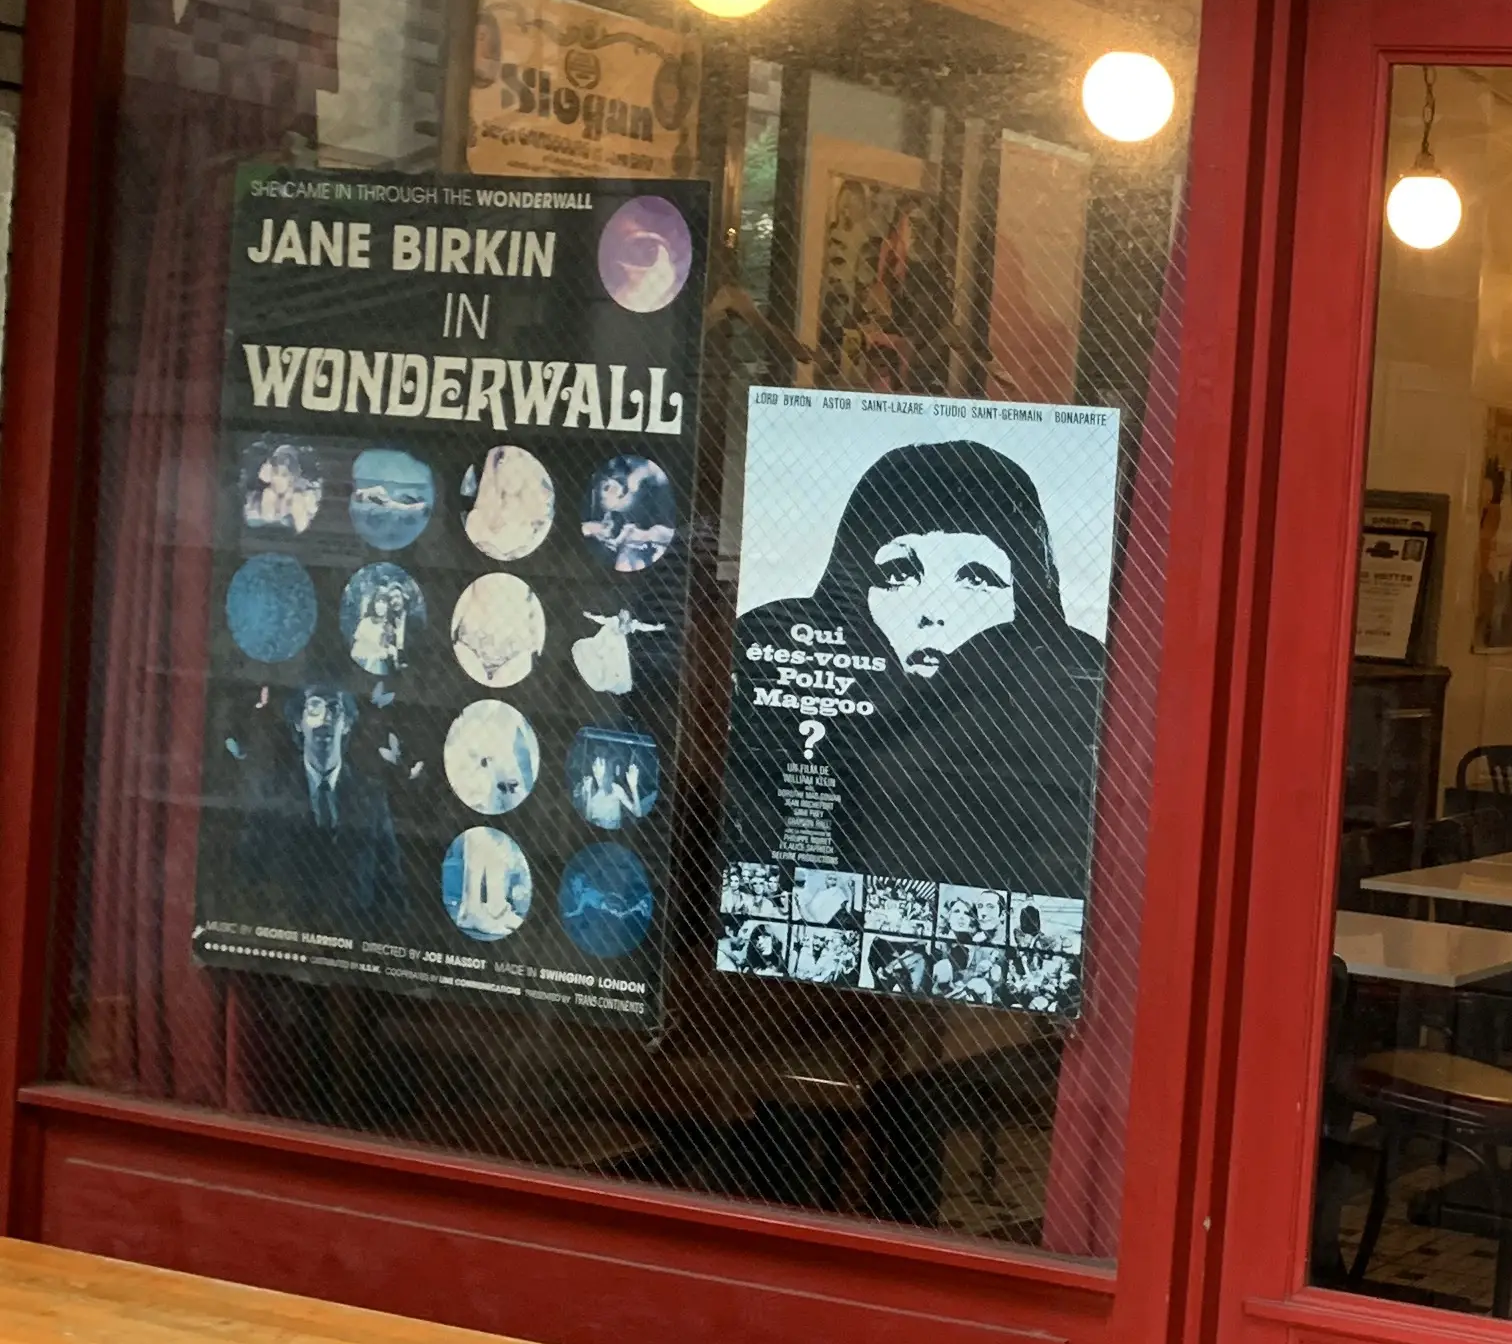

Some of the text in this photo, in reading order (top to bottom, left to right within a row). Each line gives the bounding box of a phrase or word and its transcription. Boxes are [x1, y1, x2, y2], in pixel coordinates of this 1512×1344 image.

[251, 180, 593, 210] SHE CAME IN THROUGH THE WONDERWALL
[248, 219, 556, 278] JANE BIRKIN
[443, 292, 490, 340] IN
[243, 343, 683, 435] WONDERWALL
[756, 392, 1107, 426] LORD BYRON ASTOR SAINT-LAZARE STUDIO SAINT-GERMAIN BONAPARTE
[790, 623, 847, 646] Qui
[746, 642, 887, 672] êtes-vous
[776, 667, 856, 695] Polly
[753, 687, 874, 716] Maggoo
[798, 719, 826, 760] ?
[820, 765, 830, 776] DE
[255, 926, 298, 942] GEORGE
[302, 932, 353, 949] HARRISON
[362, 941, 406, 958] DIRECTED
[409, 948, 421, 960] BY
[422, 951, 442, 963] JOE
[445, 954, 487, 969] MASSOT
[495, 962, 524, 976] MADE
[526, 966, 538, 978] IN
[540, 968, 595, 987] SWINGING
[598, 976, 645, 994] LONDON
